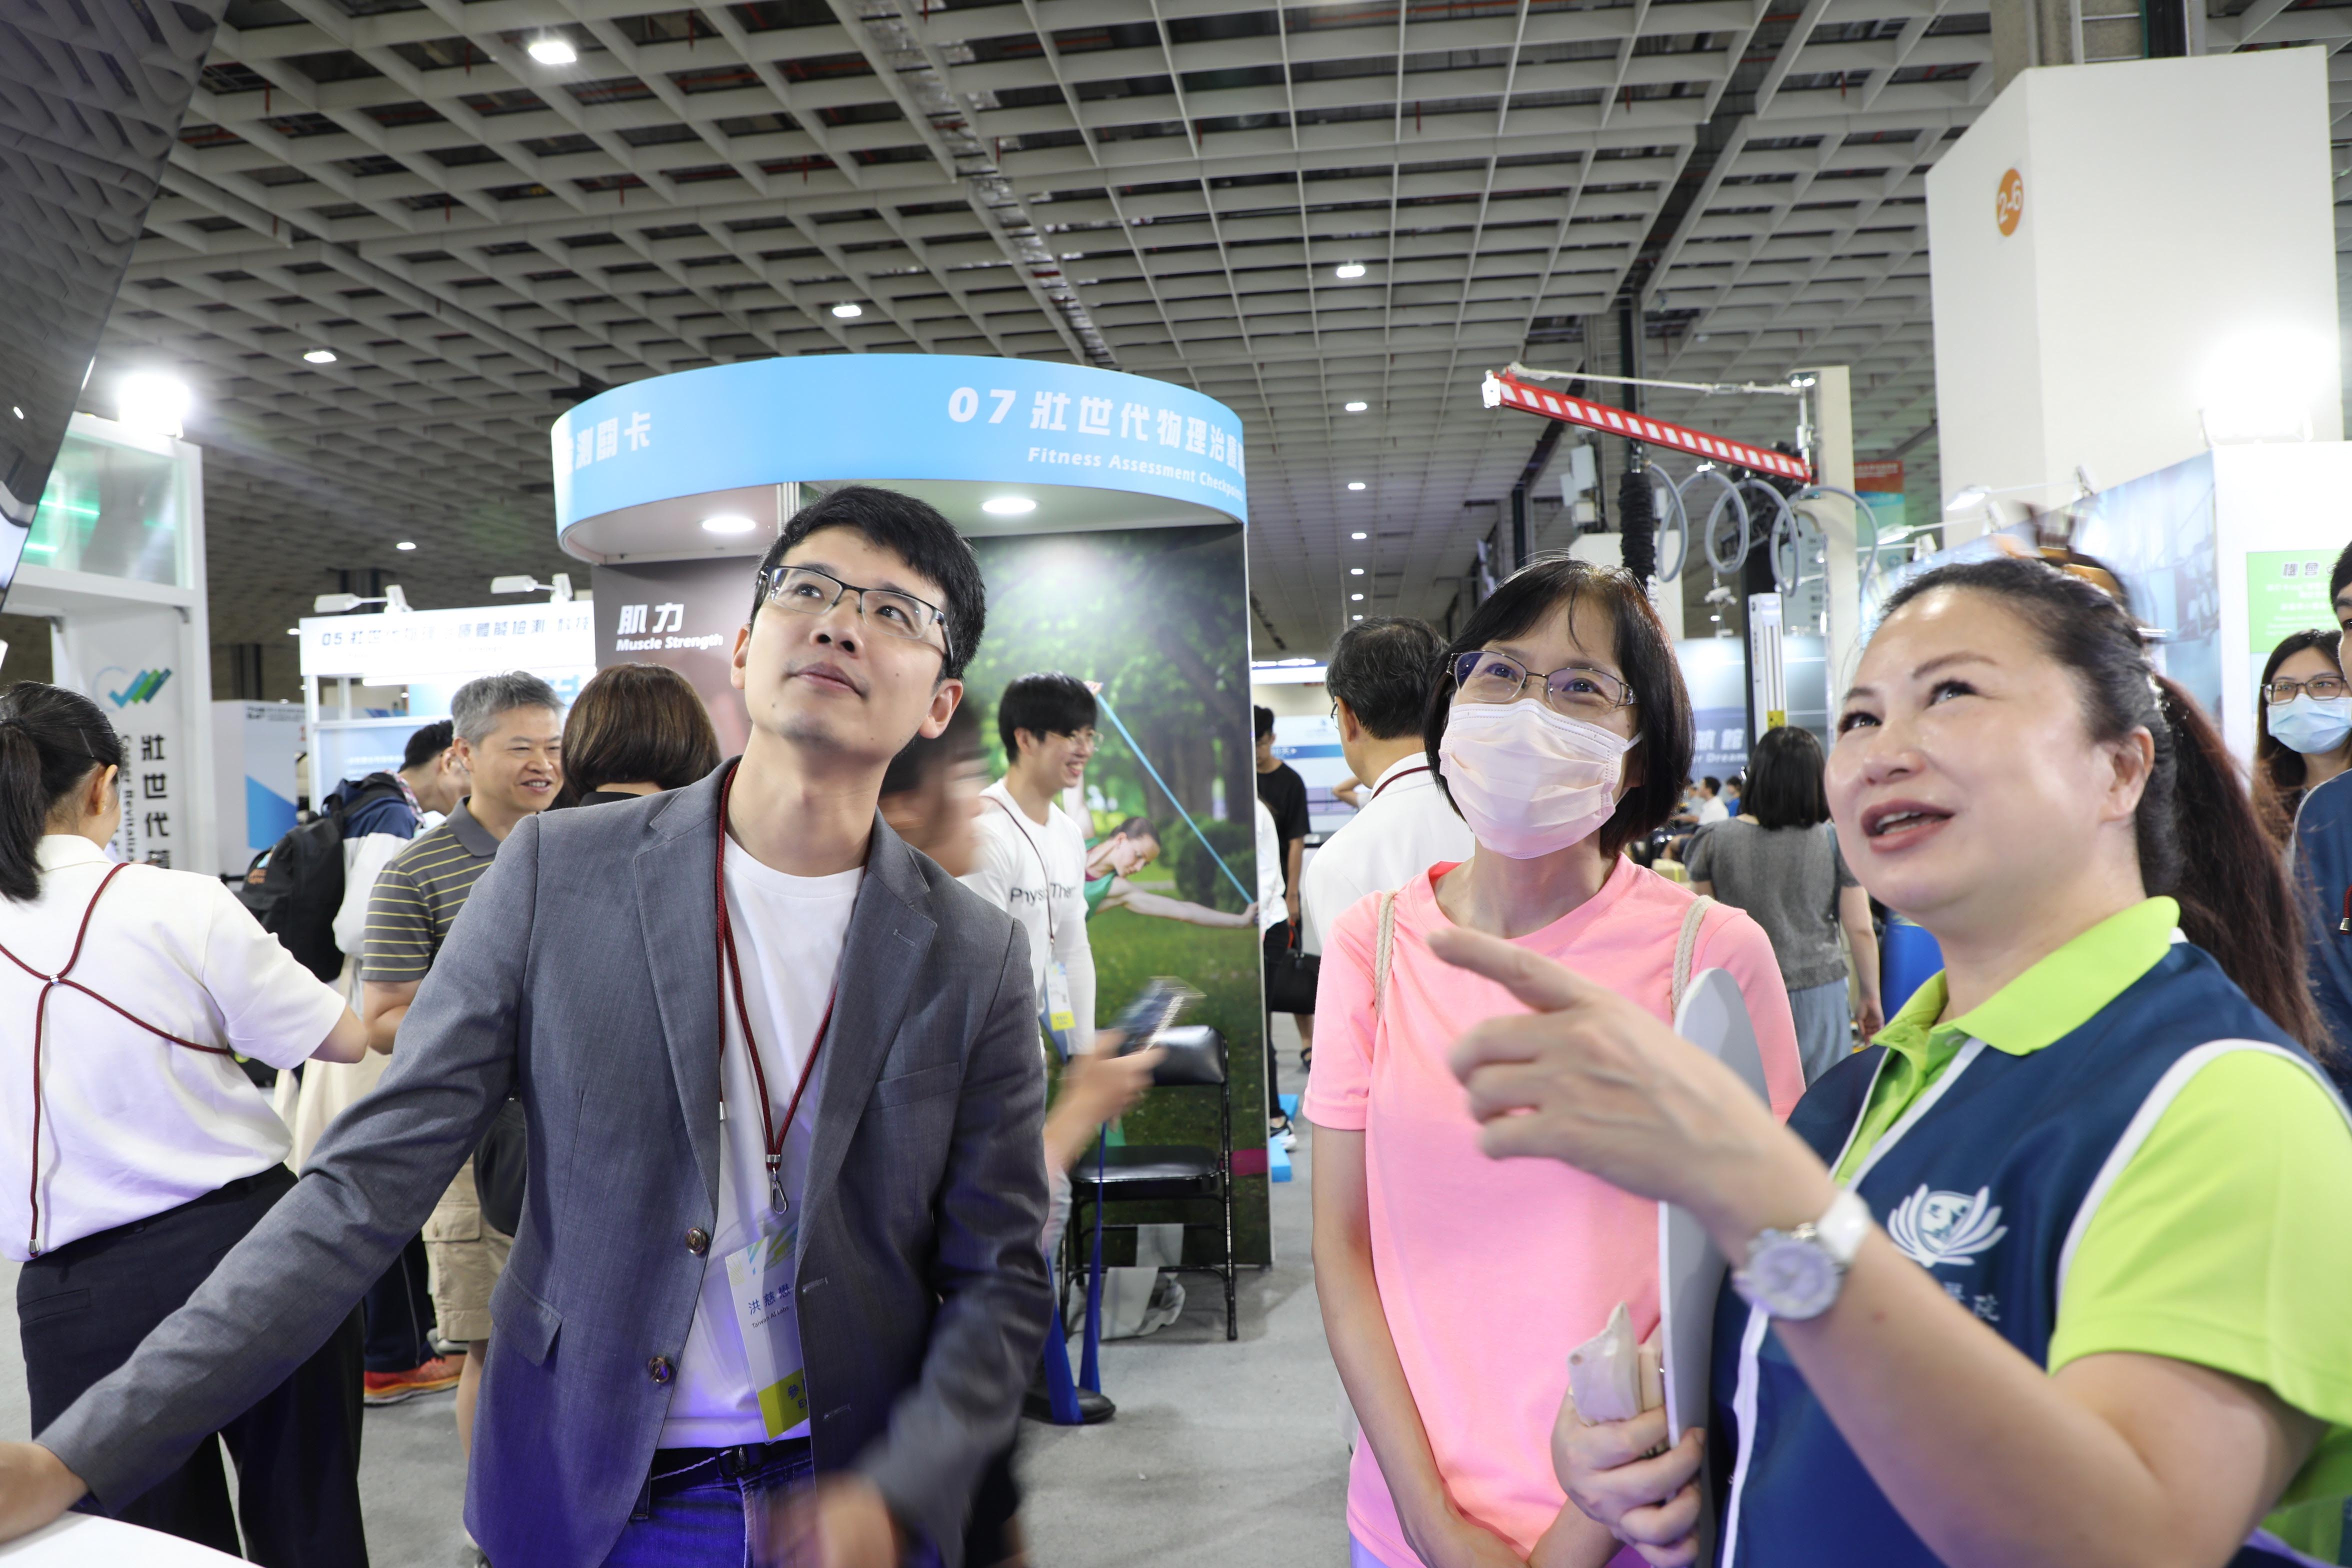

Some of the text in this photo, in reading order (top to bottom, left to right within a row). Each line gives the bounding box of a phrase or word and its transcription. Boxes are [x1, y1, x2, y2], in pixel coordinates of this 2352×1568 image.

[1998, 180, 2024, 224] 2-6
[948, 386, 1016, 424] 07
[1028, 447, 1102, 466] Fitness
[1108, 454, 1196, 484] Assessment
[616, 602, 684, 635] 肌力
[321, 632, 343, 646] 05
[616, 633, 724, 652] Muscle Strength
[752, 1316, 770, 1328] Taiwan
[777, 1306, 790, 1315] Labs
